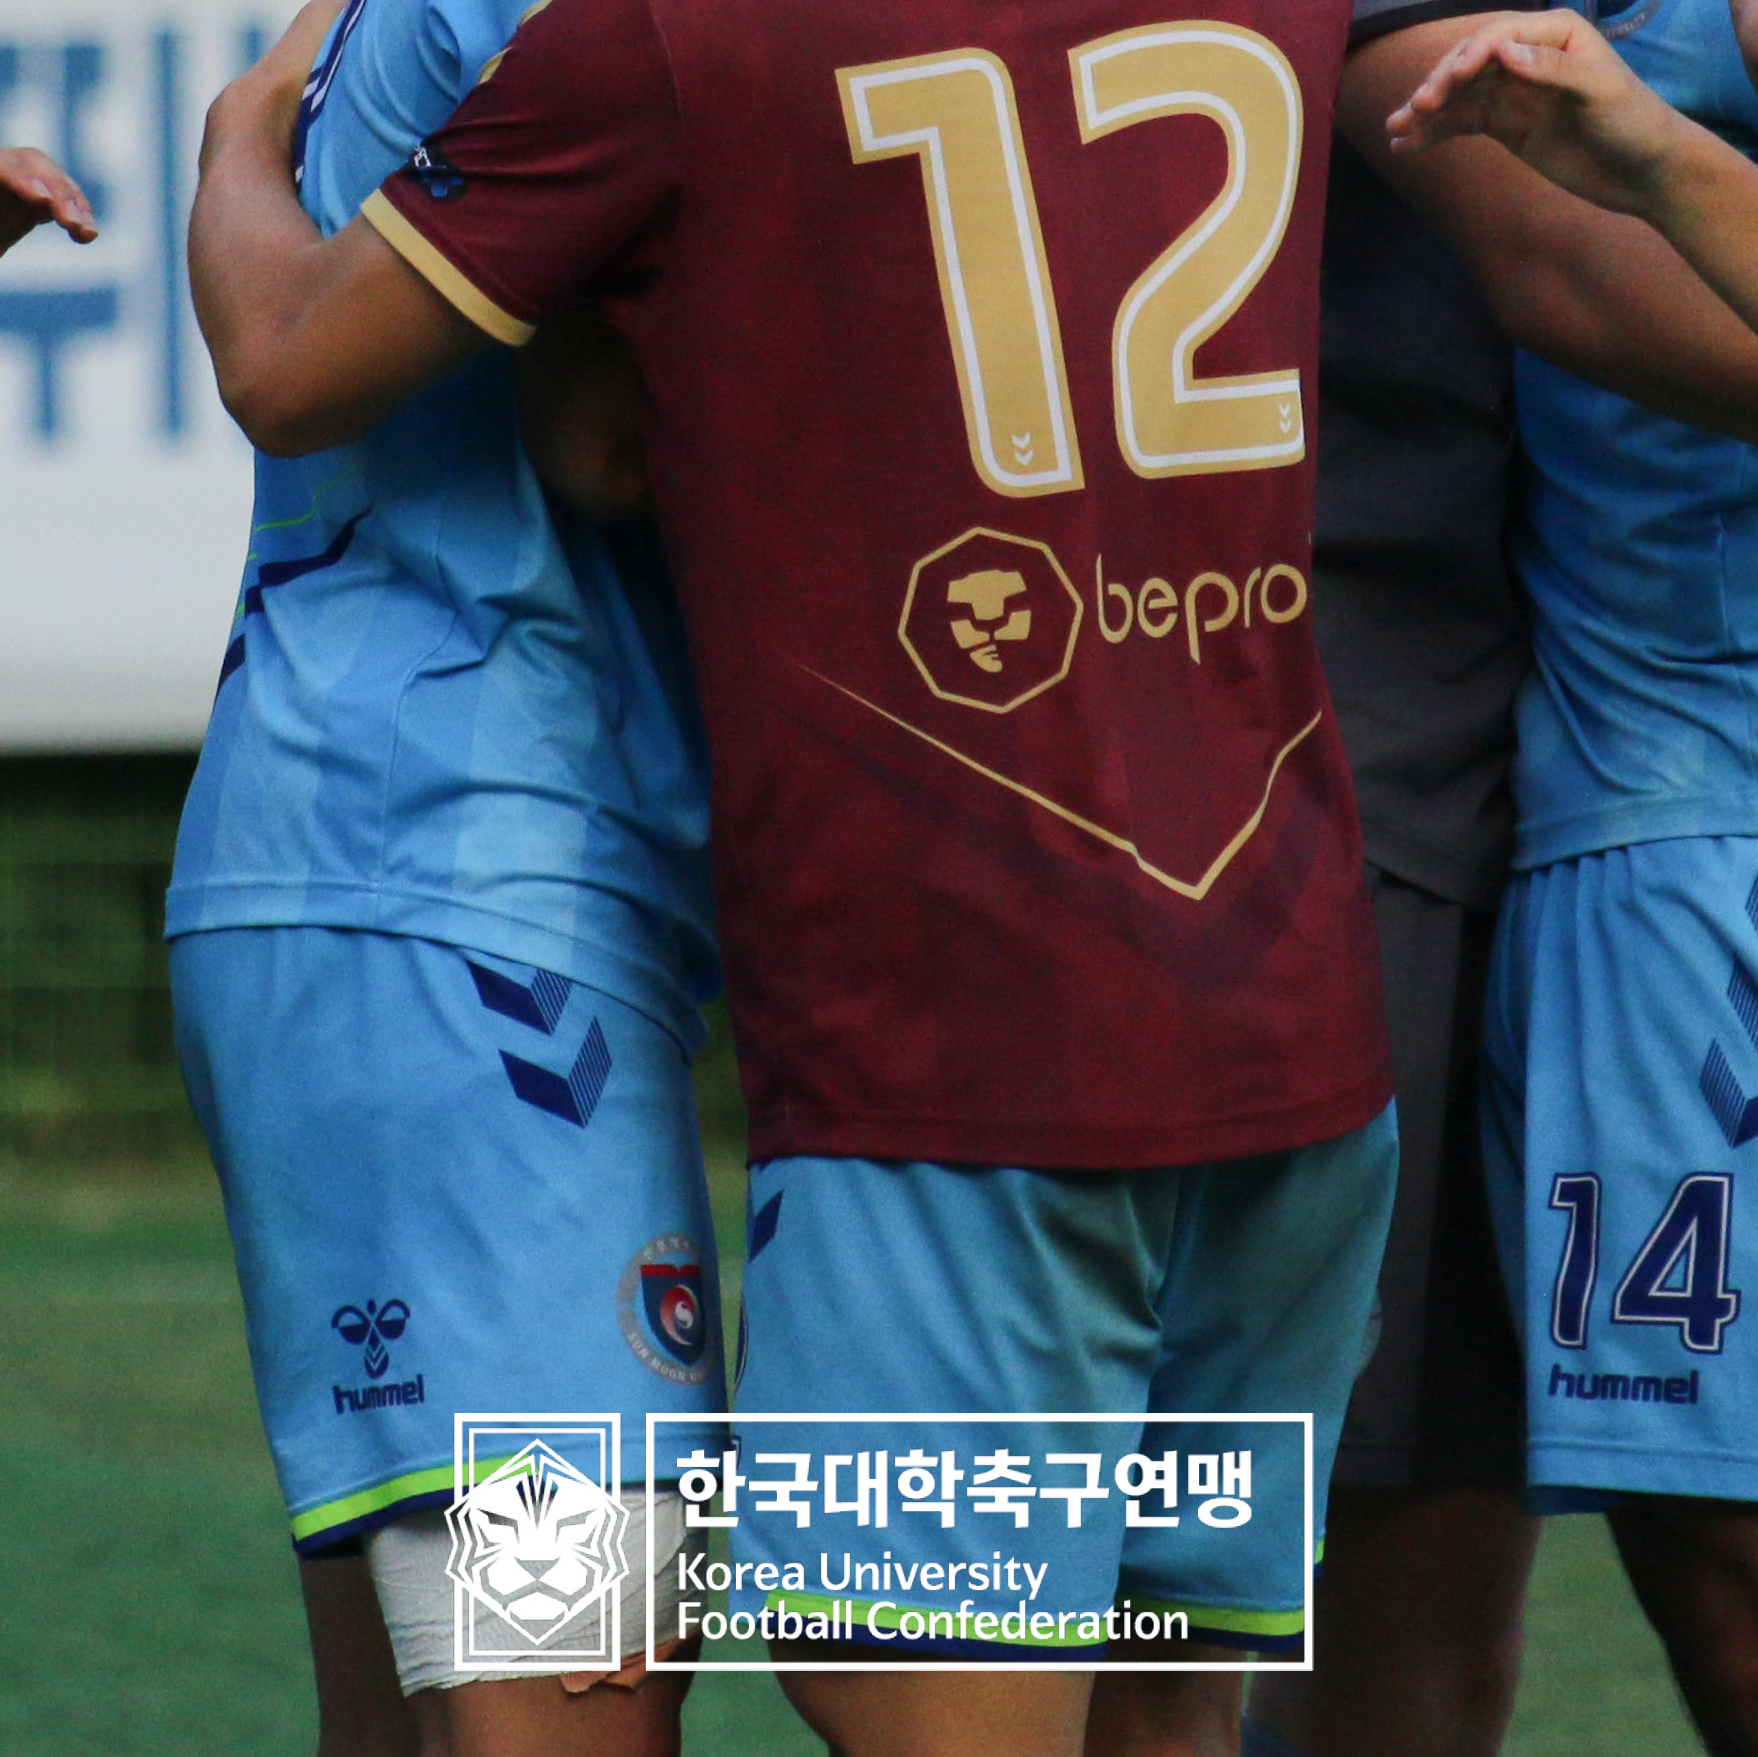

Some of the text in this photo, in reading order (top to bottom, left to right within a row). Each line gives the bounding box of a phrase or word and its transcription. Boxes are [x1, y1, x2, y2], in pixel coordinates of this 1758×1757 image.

[835, 19, 1305, 498] 12
[1095, 552, 1307, 665] bepro
[1548, 1171, 1742, 1354] 14
[333, 1374, 425, 1415] hummel
[1548, 1363, 1699, 1404] hummel
